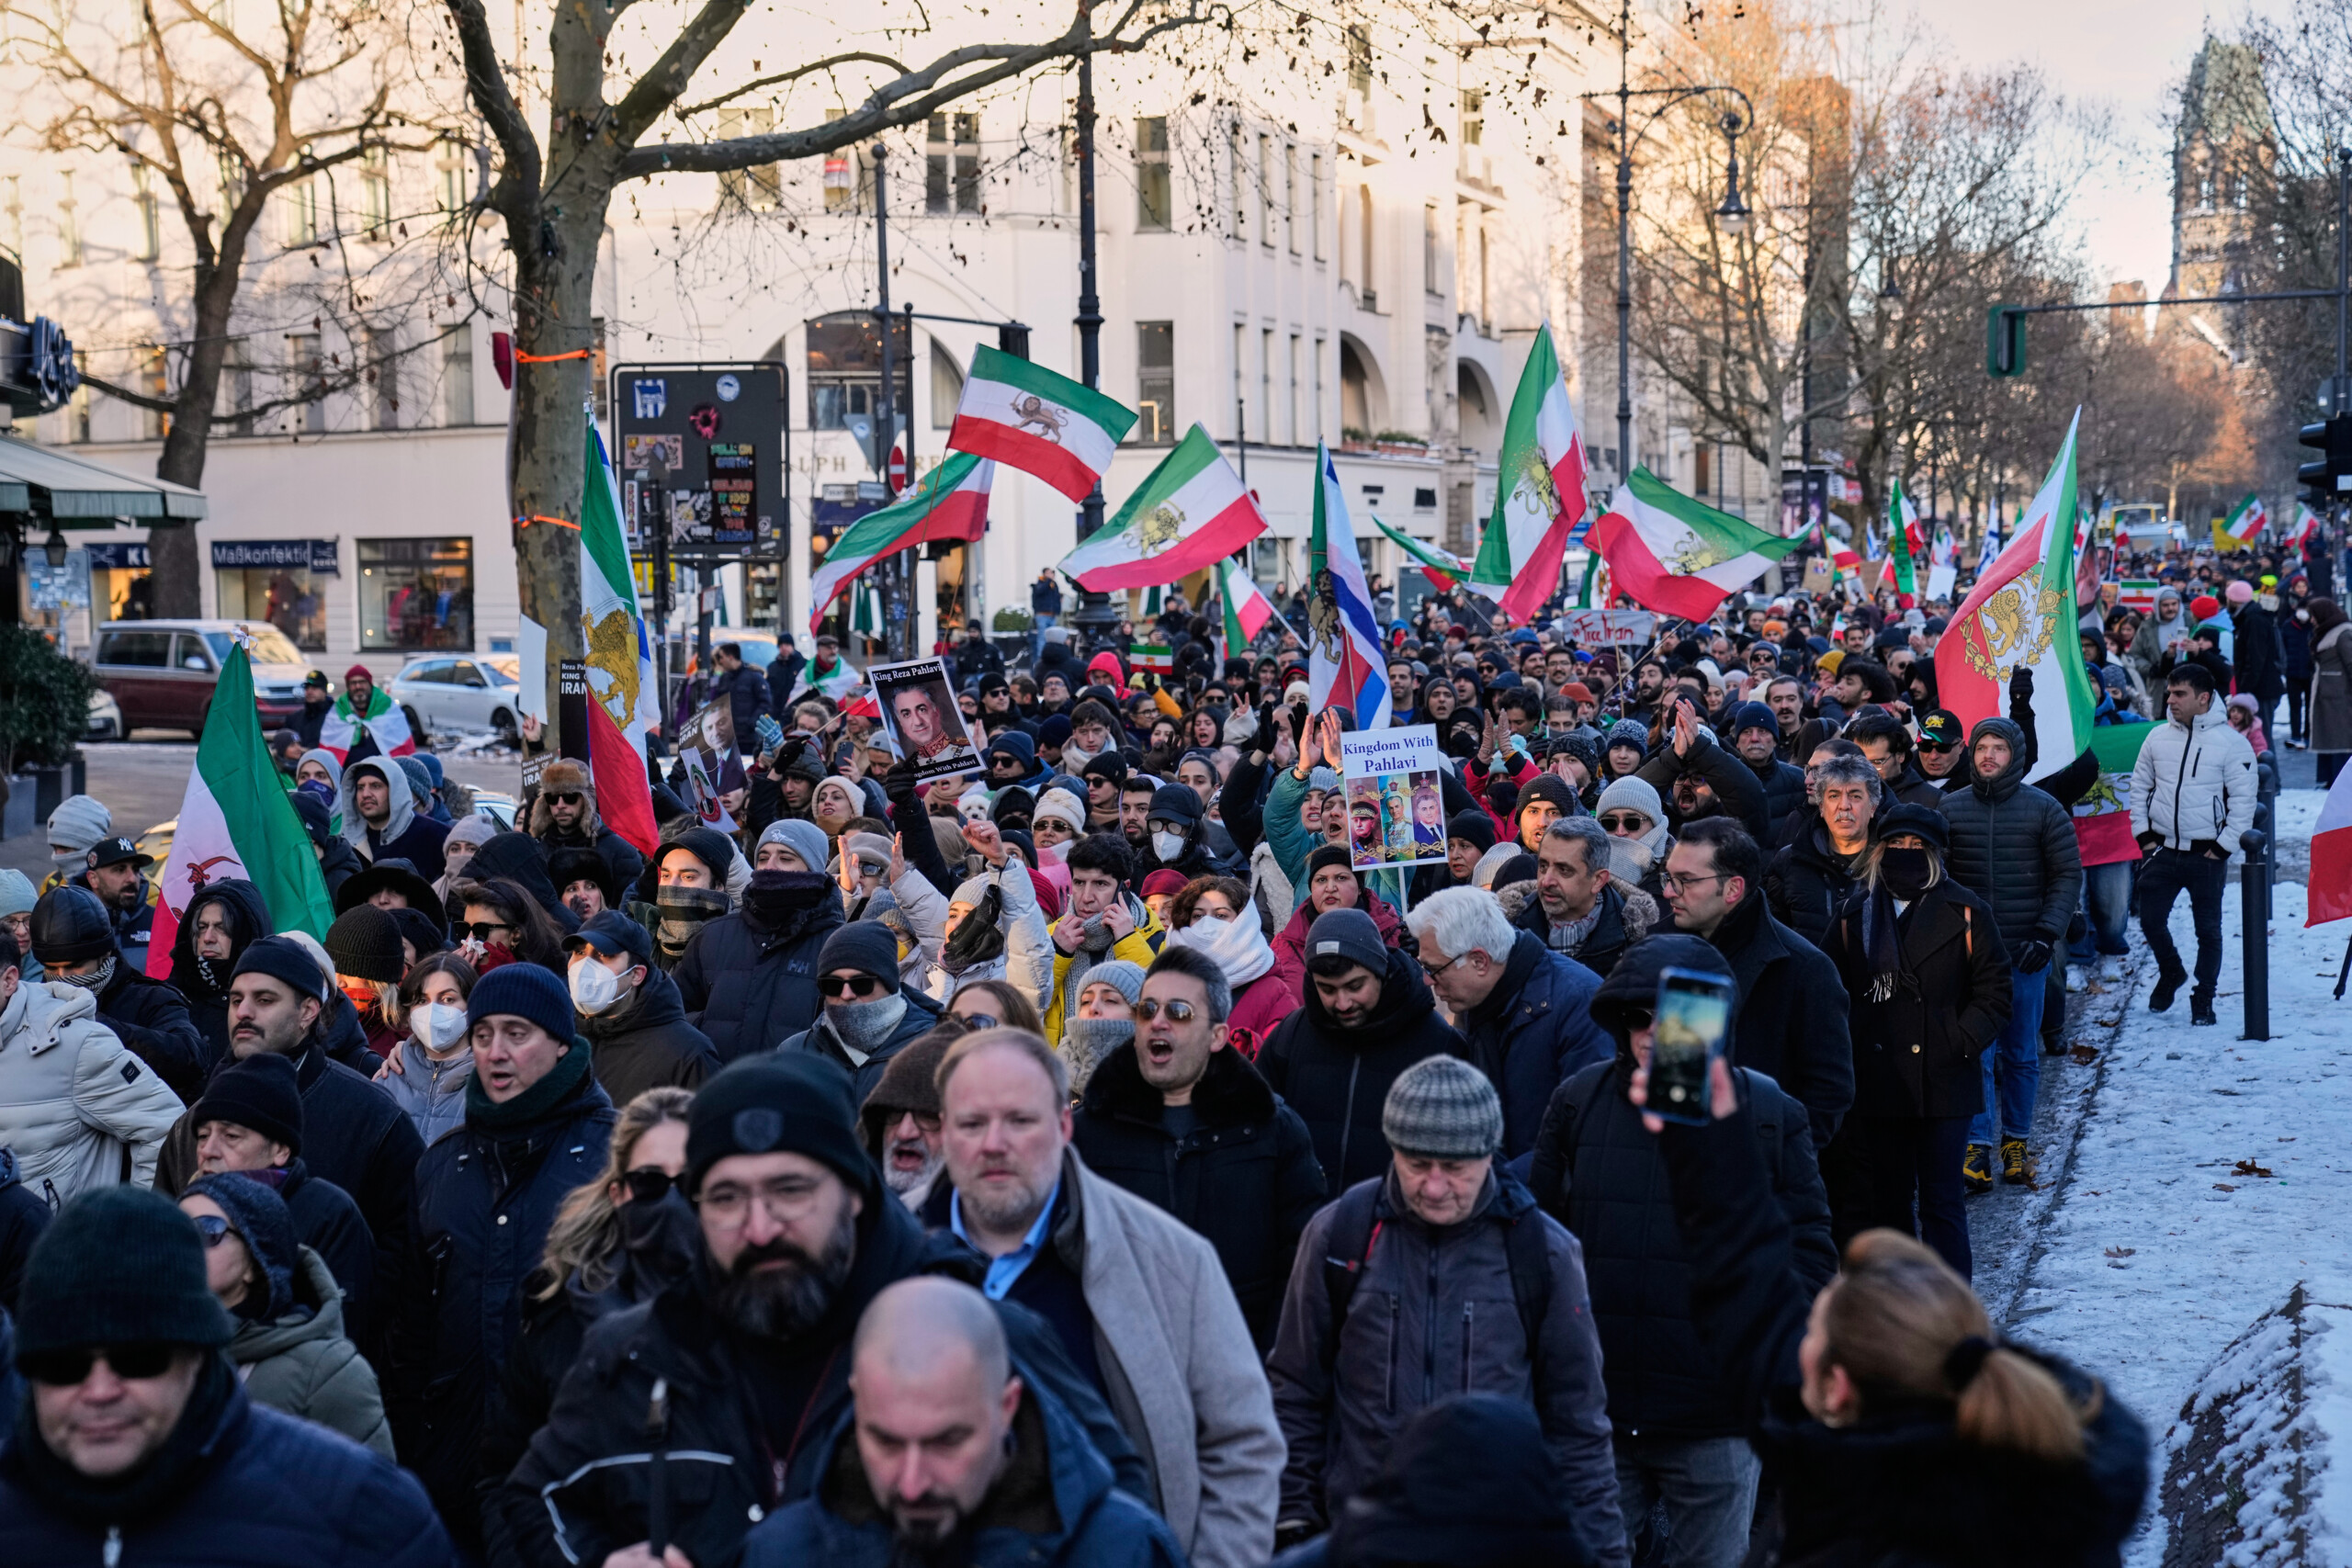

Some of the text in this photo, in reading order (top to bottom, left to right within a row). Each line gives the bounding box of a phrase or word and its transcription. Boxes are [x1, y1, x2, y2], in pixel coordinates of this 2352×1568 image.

[873, 663, 943, 682] King Reza Pahlavi
[679, 726, 698, 746] IRAN
[1344, 736, 1433, 756] Kingdom With
[523, 765, 539, 775] KING
[936, 764, 952, 773] With
[952, 760, 976, 770] Pahlavi
[1364, 755, 1417, 773] Pahlavi
[524, 772, 540, 787] IRA
